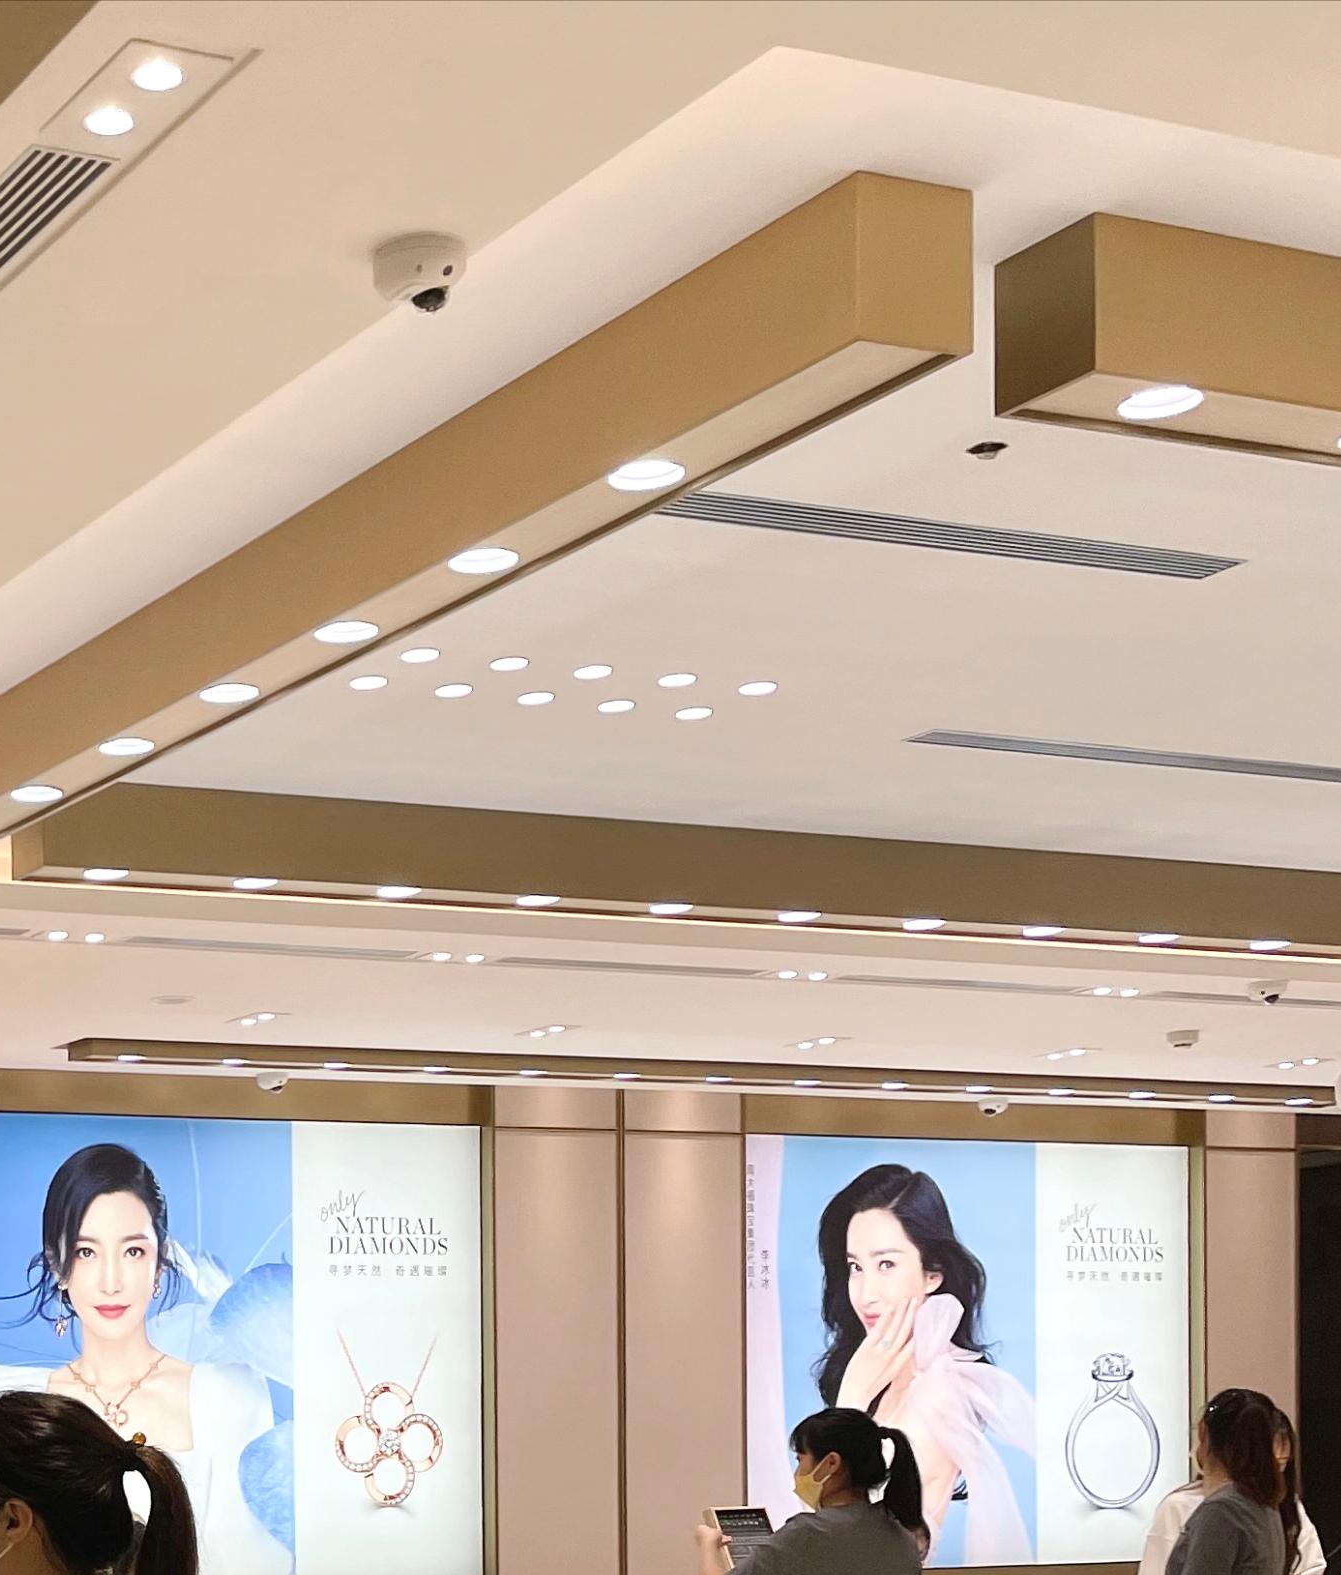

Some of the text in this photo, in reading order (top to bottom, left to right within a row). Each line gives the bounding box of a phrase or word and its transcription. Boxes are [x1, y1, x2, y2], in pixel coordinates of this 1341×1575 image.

[320, 1190, 366, 1223] only
[336, 1216, 442, 1236] NATURAL
[1071, 1227, 1159, 1245] NATURAL
[328, 1236, 448, 1256] DIAMONDS
[1066, 1245, 1164, 1263] DIAMONDS
